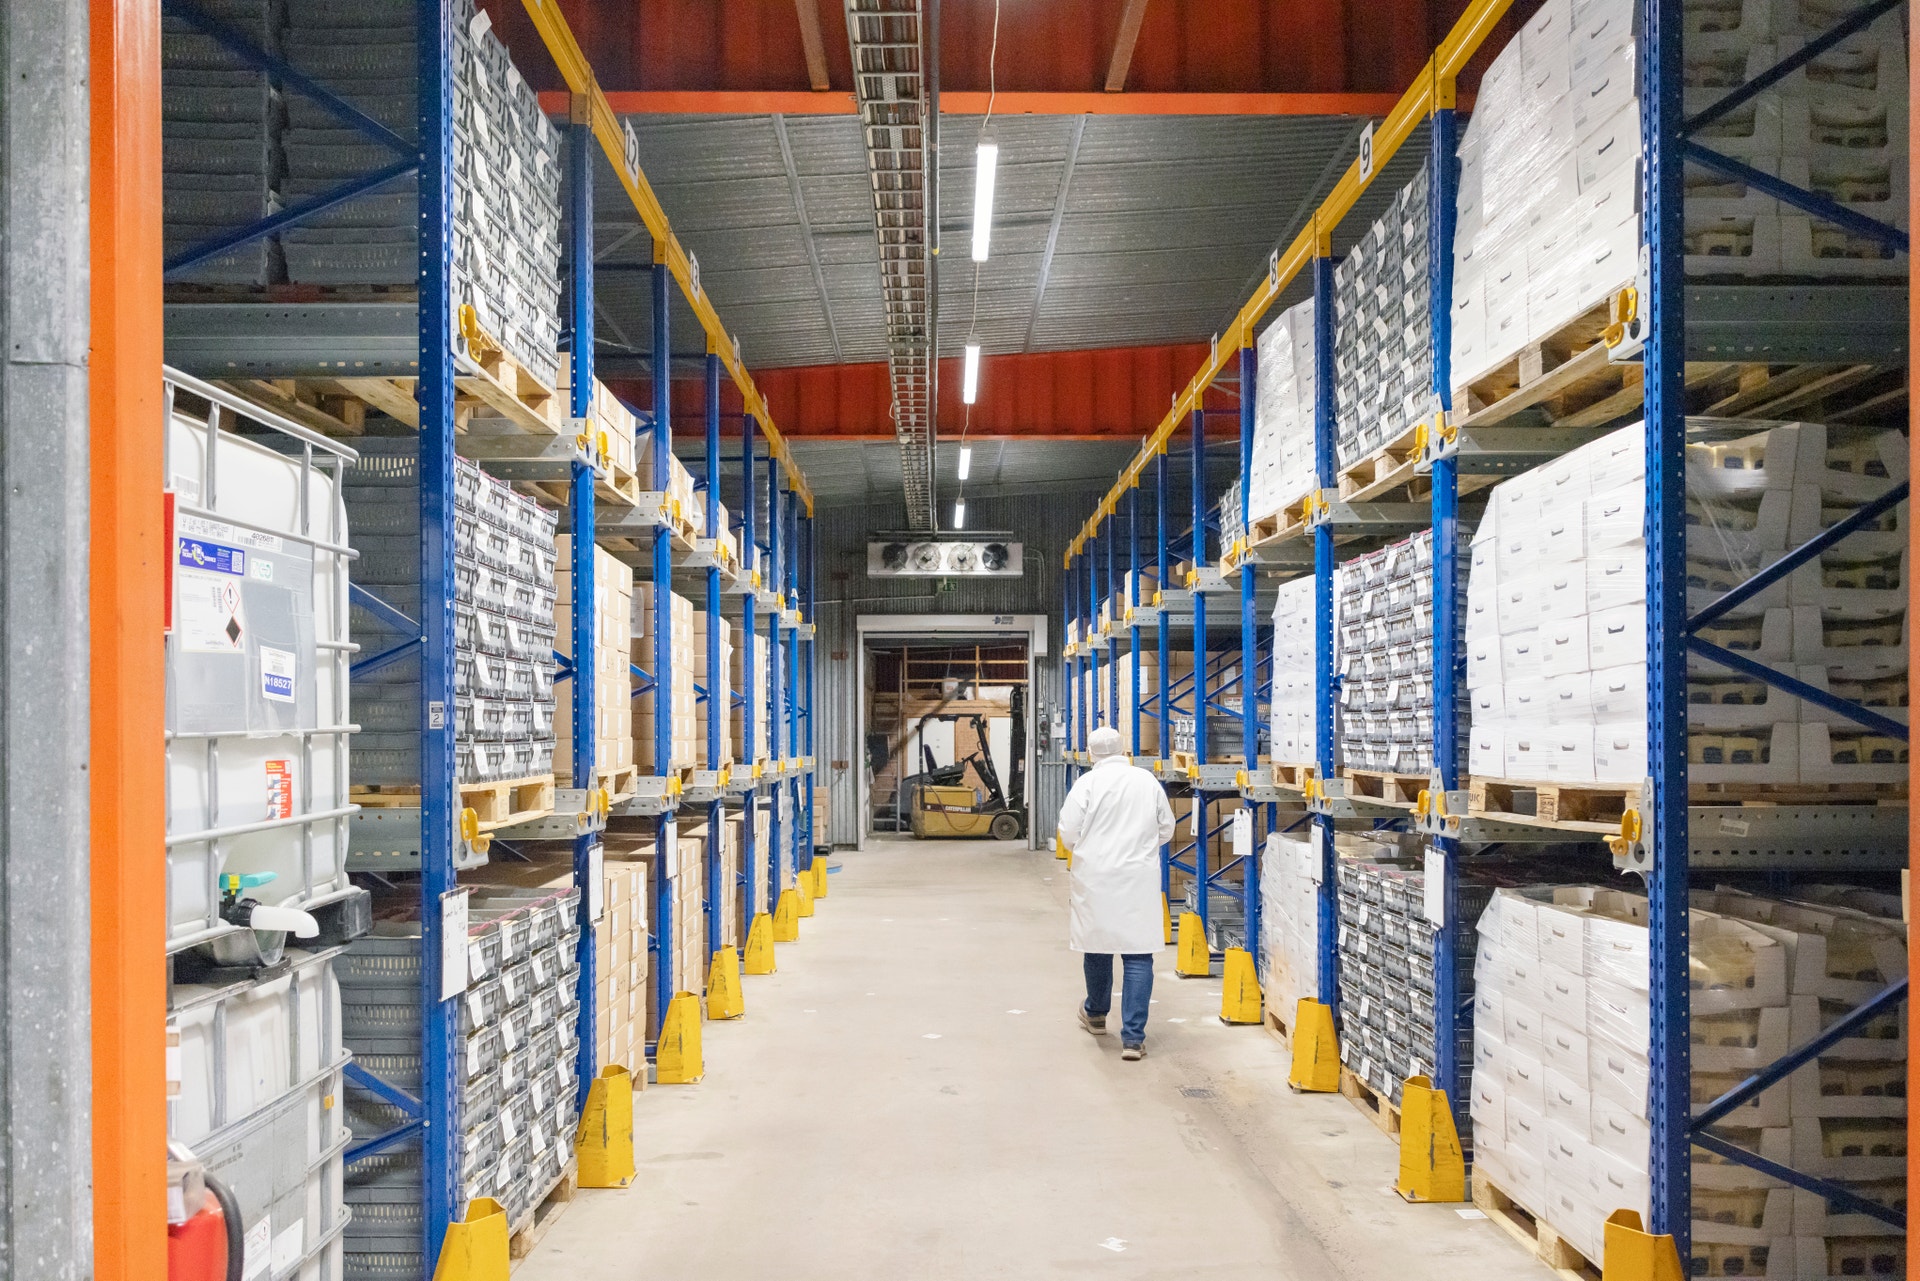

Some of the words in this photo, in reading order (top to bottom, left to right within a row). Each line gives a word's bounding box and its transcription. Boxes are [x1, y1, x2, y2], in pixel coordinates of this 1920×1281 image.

[626, 129, 637, 176] 12
[1362, 136, 1370, 175] 9
[1271, 256, 1277, 286] 8
[264, 675, 292, 690] N18527
